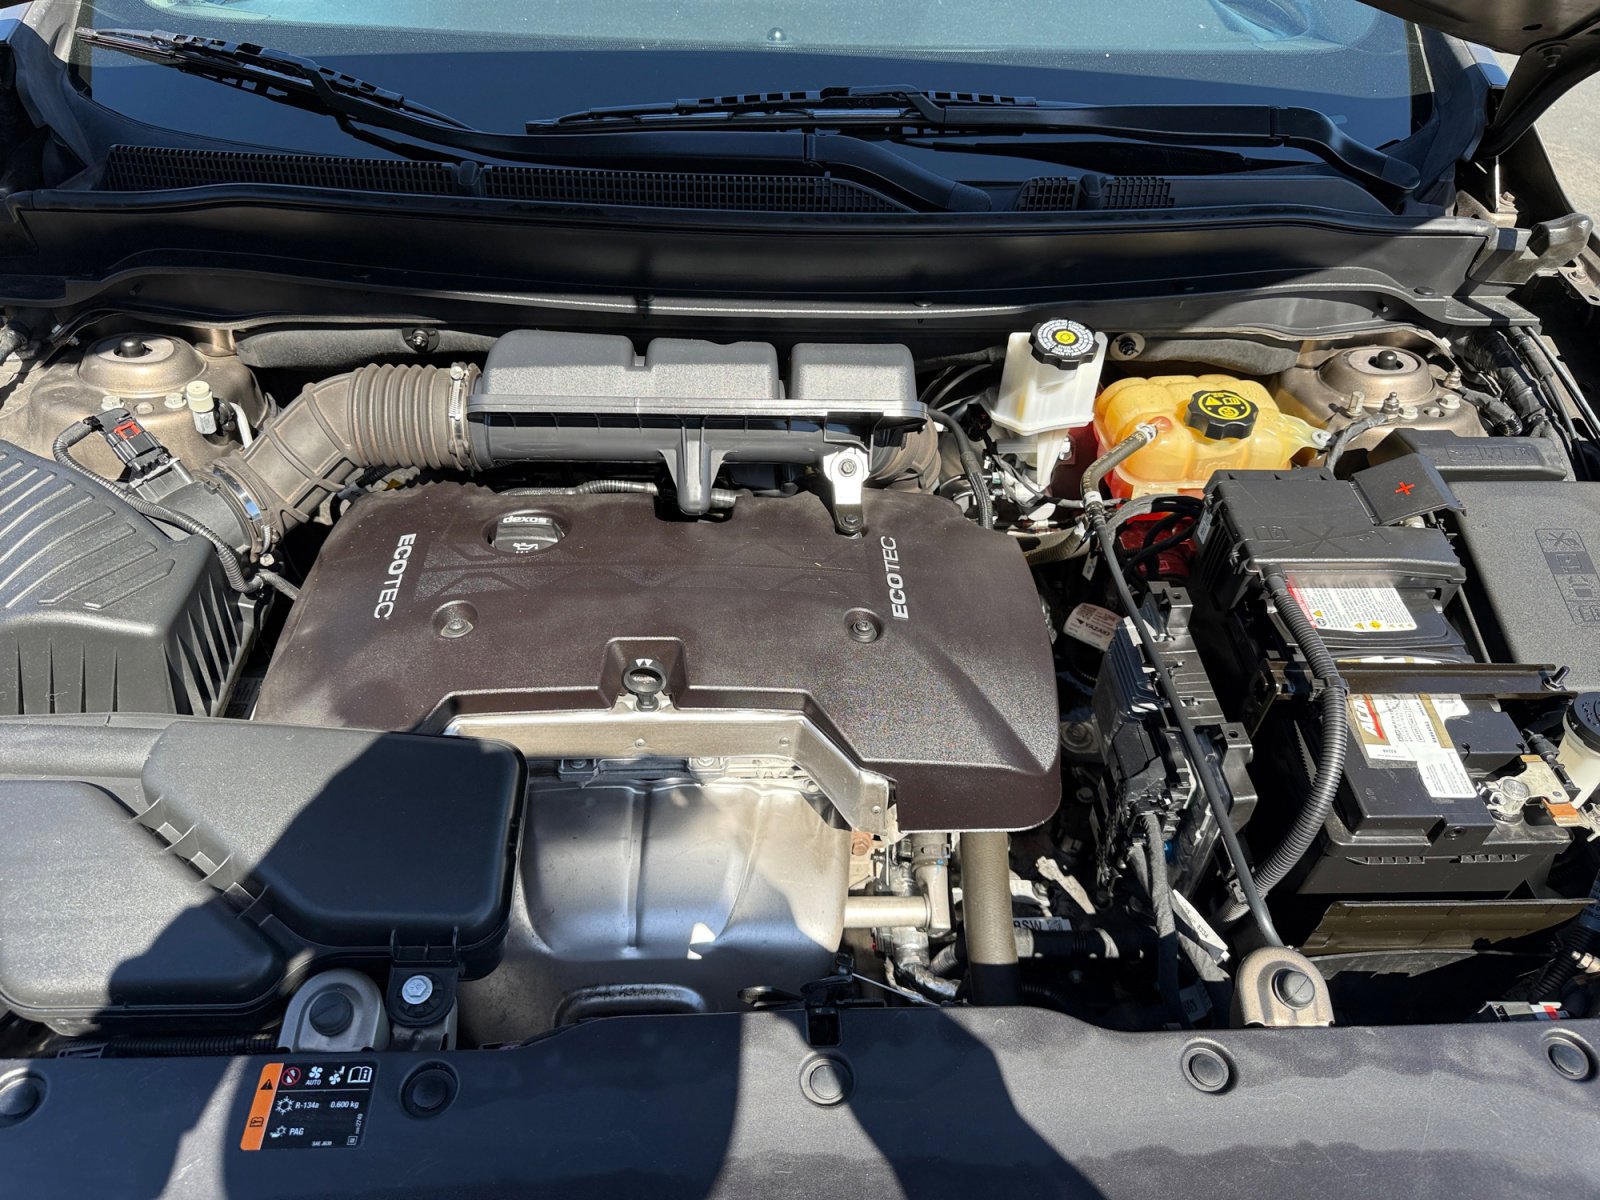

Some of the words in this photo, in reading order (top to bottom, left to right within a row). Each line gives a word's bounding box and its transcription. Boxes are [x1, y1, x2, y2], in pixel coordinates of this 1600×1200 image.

[502, 515, 547, 524] dexos
[373, 533, 417, 619] ECOTEC
[880, 535, 909, 619] ECOTEC
[295, 1101, 319, 1109] R-134a
[350, 1101, 359, 1109] kg
[289, 1127, 304, 1136] PAG
